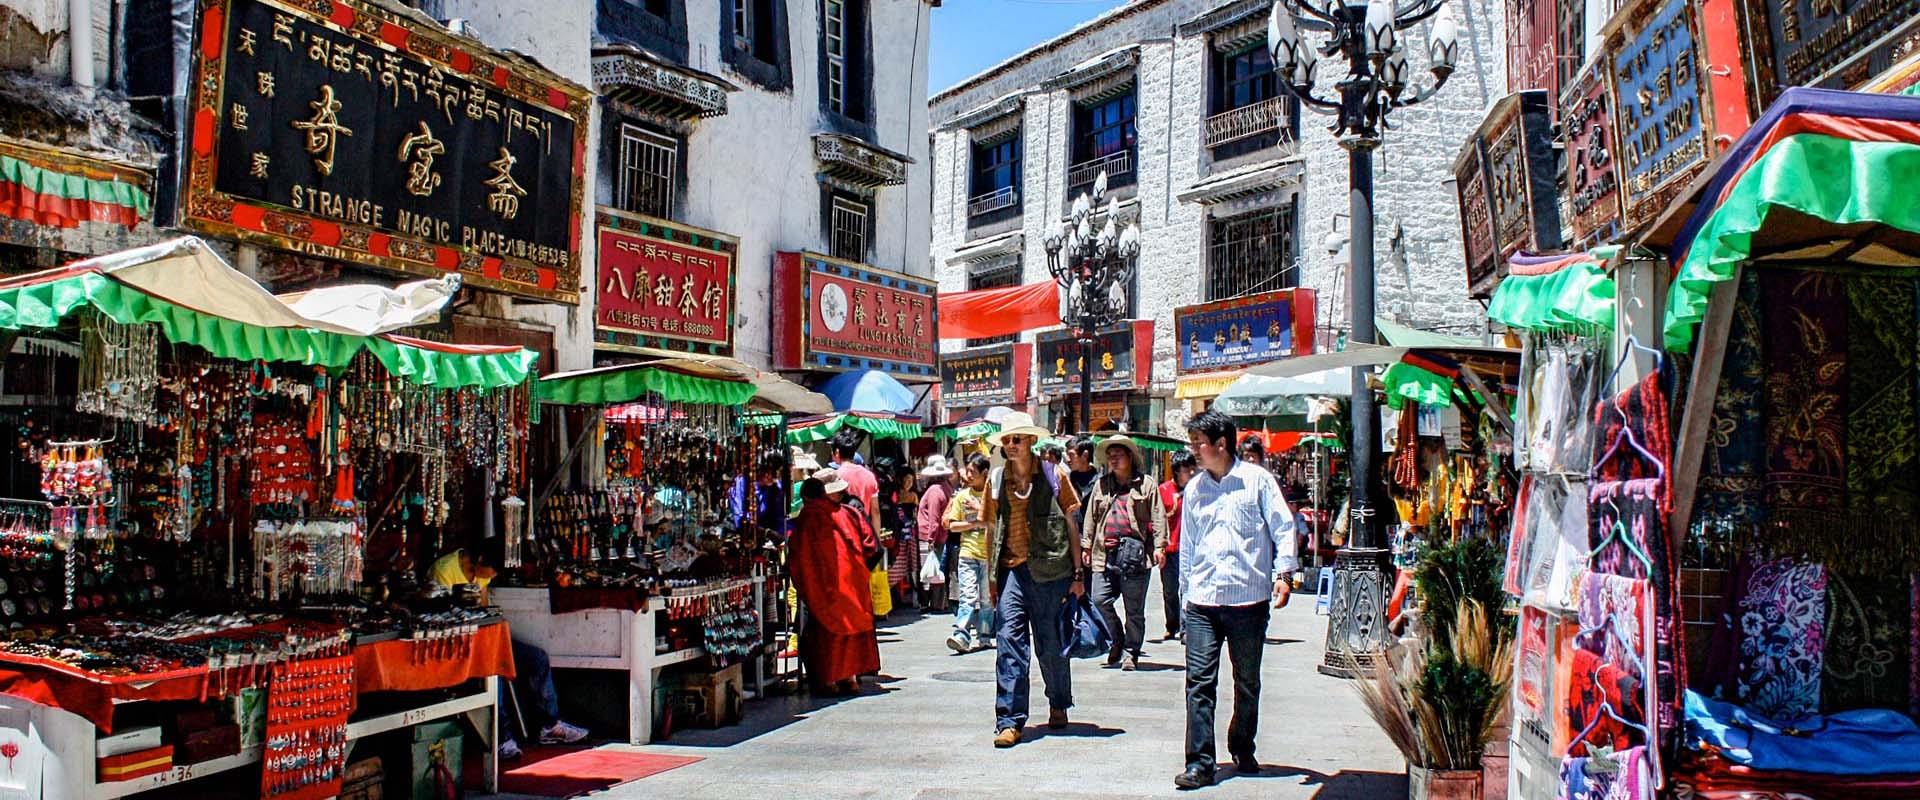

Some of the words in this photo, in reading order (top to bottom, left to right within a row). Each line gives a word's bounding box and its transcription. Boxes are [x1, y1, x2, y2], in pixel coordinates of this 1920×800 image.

[1665, 98, 1693, 141] SHOP
[290, 184, 384, 228] STRANGE
[397, 208, 450, 242] MAGIC
[462, 226, 505, 255] PLACE
[606, 267, 723, 320] 八廓甜茶馆
[854, 304, 925, 337] 隆达商店
